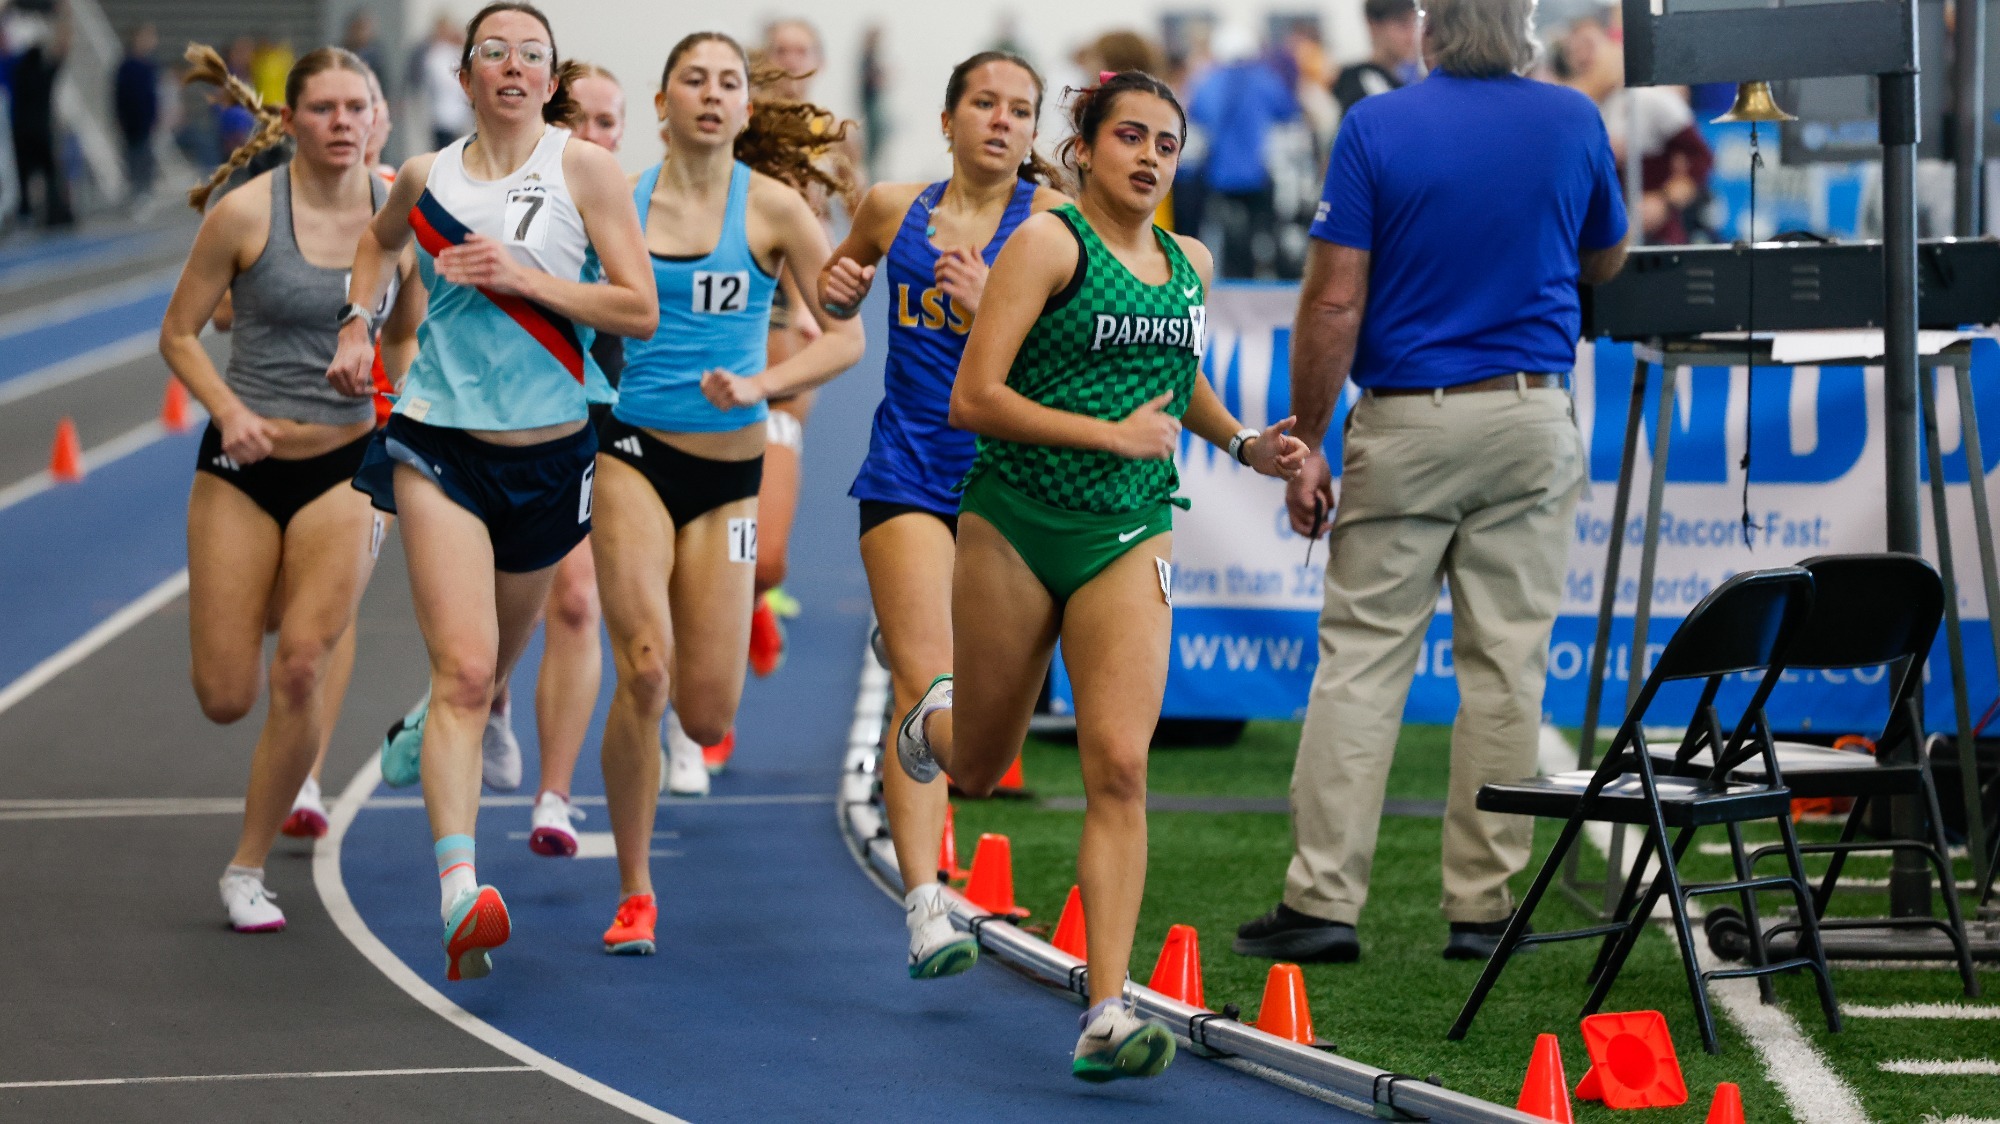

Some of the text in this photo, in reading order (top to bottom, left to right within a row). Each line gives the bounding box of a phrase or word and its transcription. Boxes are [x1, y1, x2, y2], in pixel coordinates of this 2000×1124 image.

[512, 195, 544, 241] 7
[698, 275, 741, 311] 12
[1091, 314, 1195, 351] PARKSI
[1765, 512, 1830, 547] Fast:
